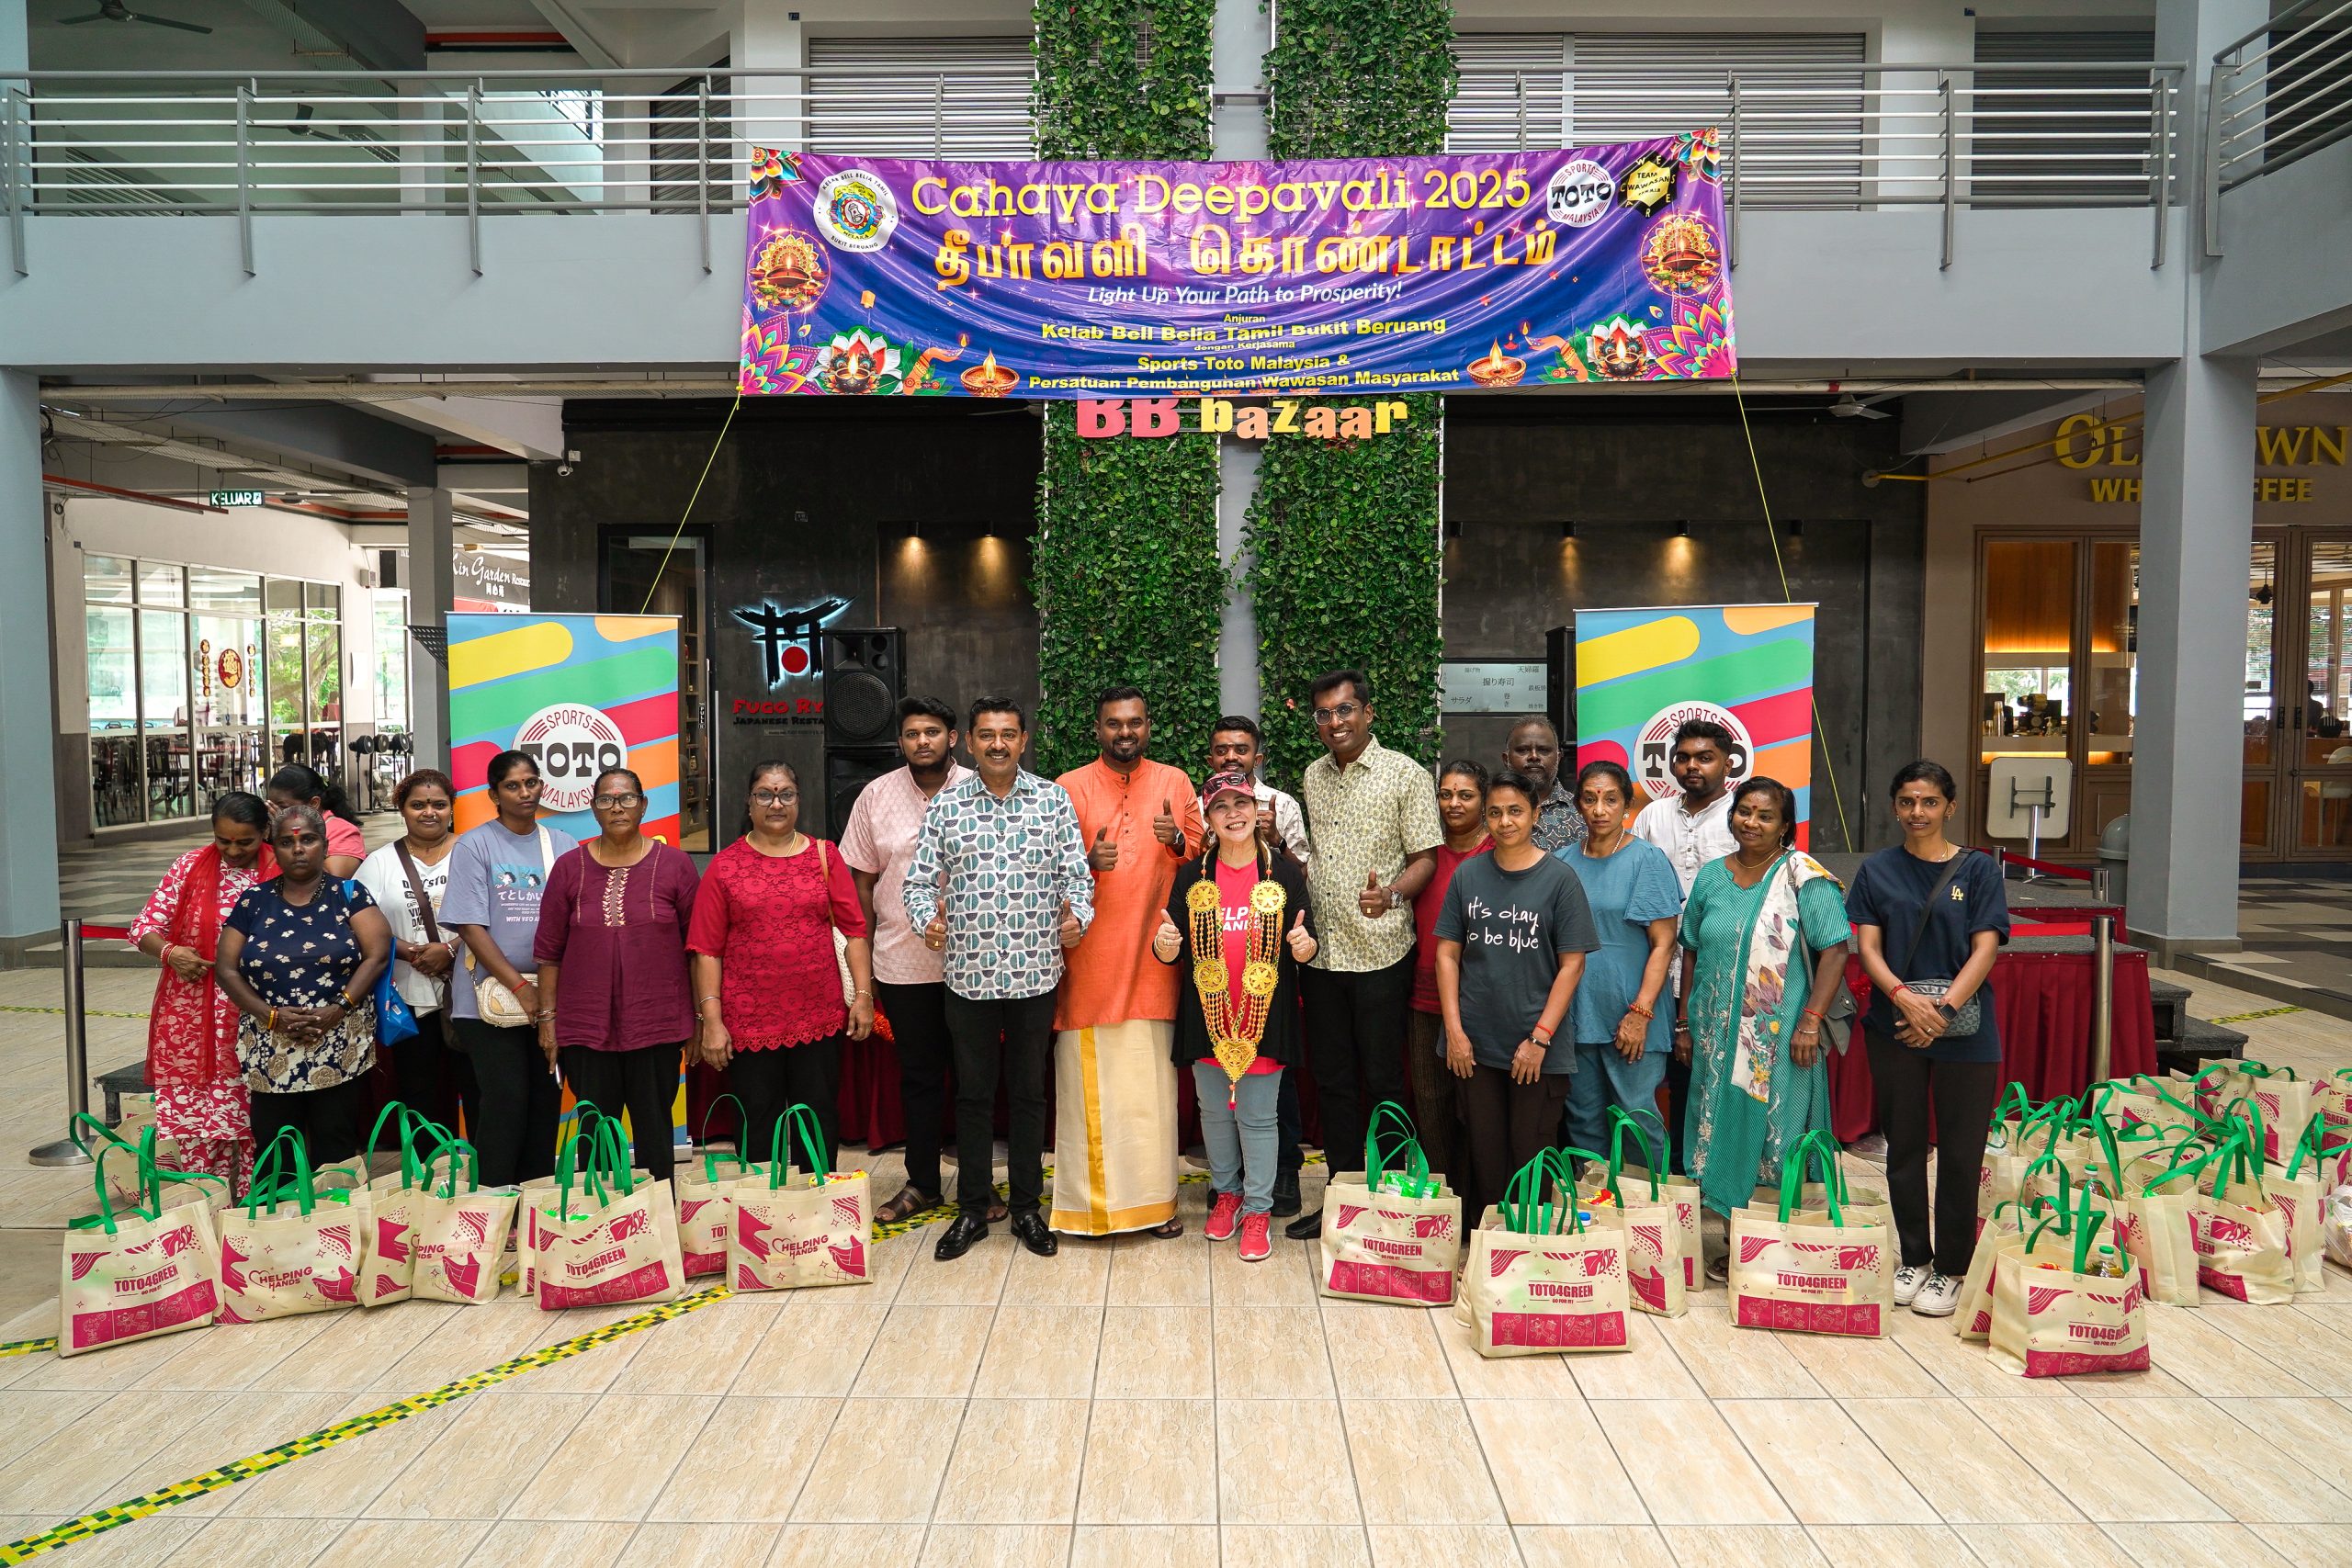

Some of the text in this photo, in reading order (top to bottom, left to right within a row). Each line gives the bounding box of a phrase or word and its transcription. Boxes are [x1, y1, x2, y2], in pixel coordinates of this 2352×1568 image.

[1565, 164, 1596, 175] SPORTS
[855, 173, 872, 182] BELIA
[874, 180, 888, 197] TAMIL
[1627, 176, 1670, 191] WAWASAN
[911, 176, 1120, 223] Cahaya
[1134, 170, 1410, 224] Deepavali
[1424, 169, 1532, 210] 2025
[1551, 183, 1611, 209] TOTO
[1562, 208, 1600, 223] MALAYSIA
[831, 235, 847, 247] BUKIT
[1088, 281, 1402, 306] Light Up Your Path to Prosperity!
[1224, 313, 1266, 324] Anjuran
[1042, 318, 1446, 342] Kelab Bell Belia Tamil Bukit Beruang
[1238, 341, 1295, 351] Kerjasama
[1137, 354, 1351, 374] Sports Toto Malaysia &
[1029, 368, 1460, 391] Persatuan Pembangunan Wawasan Masyarakat
[1076, 397, 1408, 439] BB bazaar
[211, 491, 253, 505] KELUAR
[471, 556, 510, 586] Garden
[1483, 677, 1515, 686] 握り寿司
[732, 699, 789, 715] FUGO
[1451, 696, 1473, 705] サラダ
[546, 709, 593, 729] SPORTS
[733, 716, 825, 726] JAPANESE RESTA
[1951, 886, 1964, 900] LA
[1468, 897, 1539, 935] It's okay
[1485, 927, 1504, 945] be
[1509, 928, 1539, 954] blue
[781, 1235, 830, 1252] HELPING
[1363, 1238, 1422, 1257] TOTO4GREEN
[565, 1248, 627, 1276] TOTO4GREEN
[790, 1247, 819, 1260] HANDS
[114, 1264, 178, 1292] TOTO4GREEN
[259, 1266, 313, 1283] HELPING
[1777, 1272, 1848, 1290] TOTO4GREEN
[268, 1278, 301, 1292] HANDS
[1528, 1283, 1593, 1298] TOTO4GREEN
[2068, 1322, 2131, 1340] TOTO4GREEN
